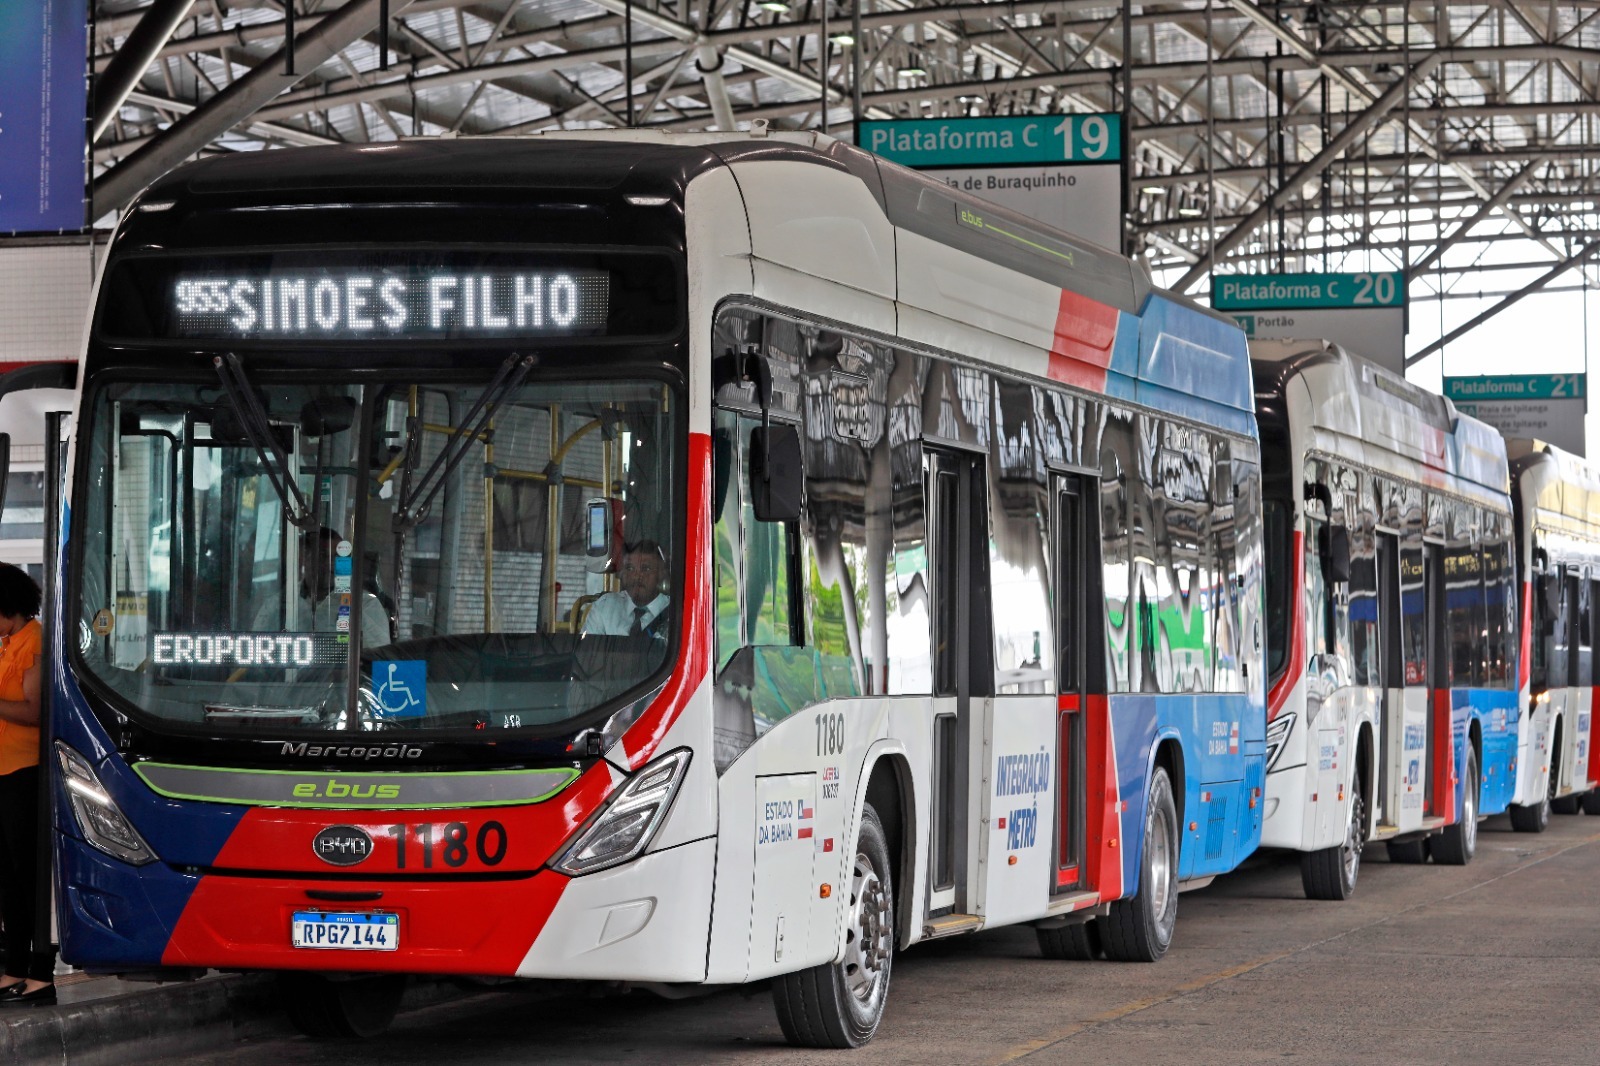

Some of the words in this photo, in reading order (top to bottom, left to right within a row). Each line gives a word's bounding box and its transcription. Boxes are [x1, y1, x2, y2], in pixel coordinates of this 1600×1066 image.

[872, 125, 1013, 151] Plataforma
[1022, 123, 1039, 147] C
[1053, 116, 1110, 160] 19
[964, 176, 983, 190] de
[987, 172, 1077, 191] Buraquinho
[961, 210, 983, 228] e.bus
[1223, 281, 1321, 300] Plataforma
[1327, 281, 1339, 298] C
[1352, 273, 1395, 304] 20
[231, 277, 407, 331] SIMOES
[431, 274, 578, 327] FILHO
[1257, 316, 1295, 327] Portão
[1451, 379, 1524, 394] Plataforma
[1528, 379, 1537, 392] C
[1551, 374, 1579, 397] 21
[153, 634, 314, 665] EROPORTO
[815, 712, 845, 756] 1180
[281, 742, 423, 760] Marcopolo
[996, 745, 1050, 799] INTEGRAÇÃO
[292, 779, 401, 798] e.bus
[765, 800, 793, 821] ESTADO
[758, 825, 770, 844] DA
[771, 823, 792, 843] BAHIA
[1007, 800, 1037, 851] METRÔ
[319, 836, 366, 854] BYD
[388, 820, 508, 869] 1180
